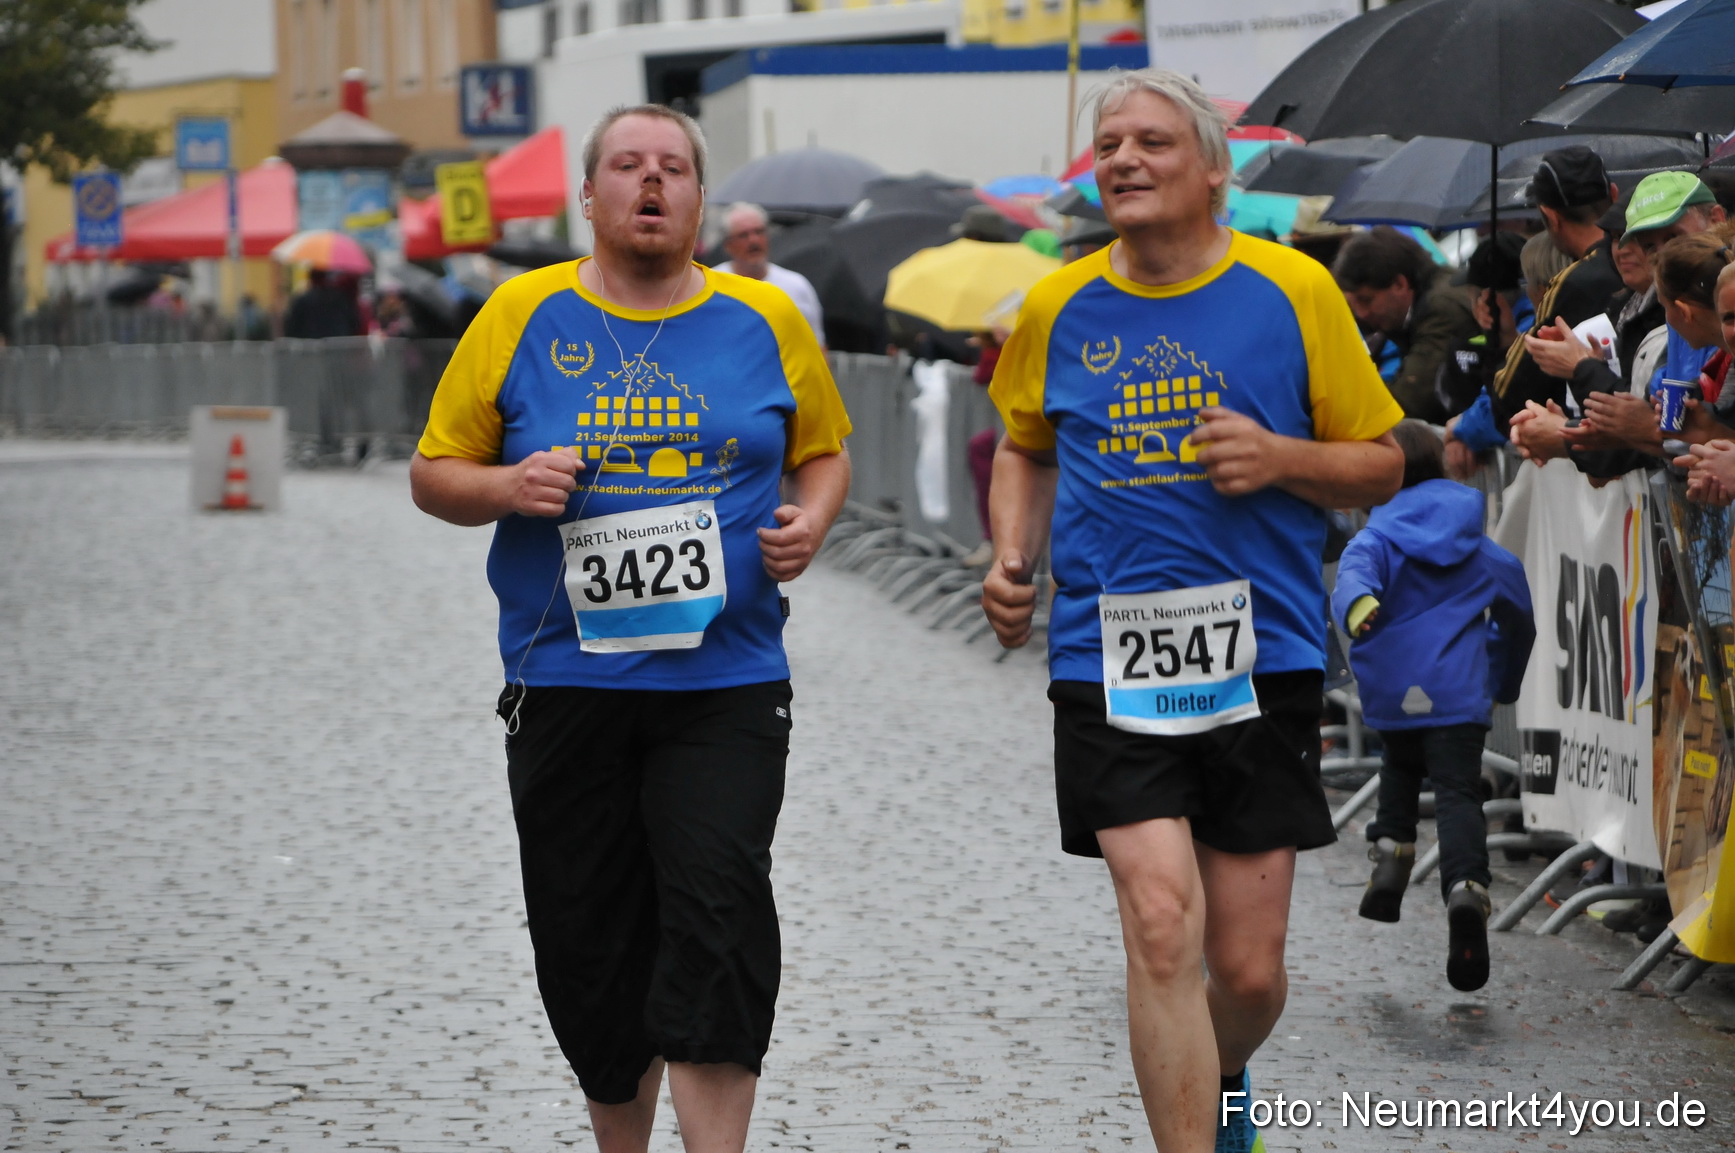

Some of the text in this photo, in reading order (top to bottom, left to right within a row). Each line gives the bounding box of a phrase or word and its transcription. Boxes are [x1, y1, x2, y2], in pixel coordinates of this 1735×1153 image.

[453, 187, 482, 223] D
[566, 343, 578, 351] 15
[1090, 350, 1113, 362] Jahre
[559, 353, 585, 363] Jahre
[1111, 416, 1190, 435] 21.September
[575, 432, 699, 443] 21.September 2014
[566, 519, 690, 550] PARTL Neumarkt
[582, 538, 711, 604] 3423
[1104, 601, 1226, 622] PARTL Neumarkt
[1119, 619, 1240, 680] 2547
[1156, 693, 1216, 714] Dieter
